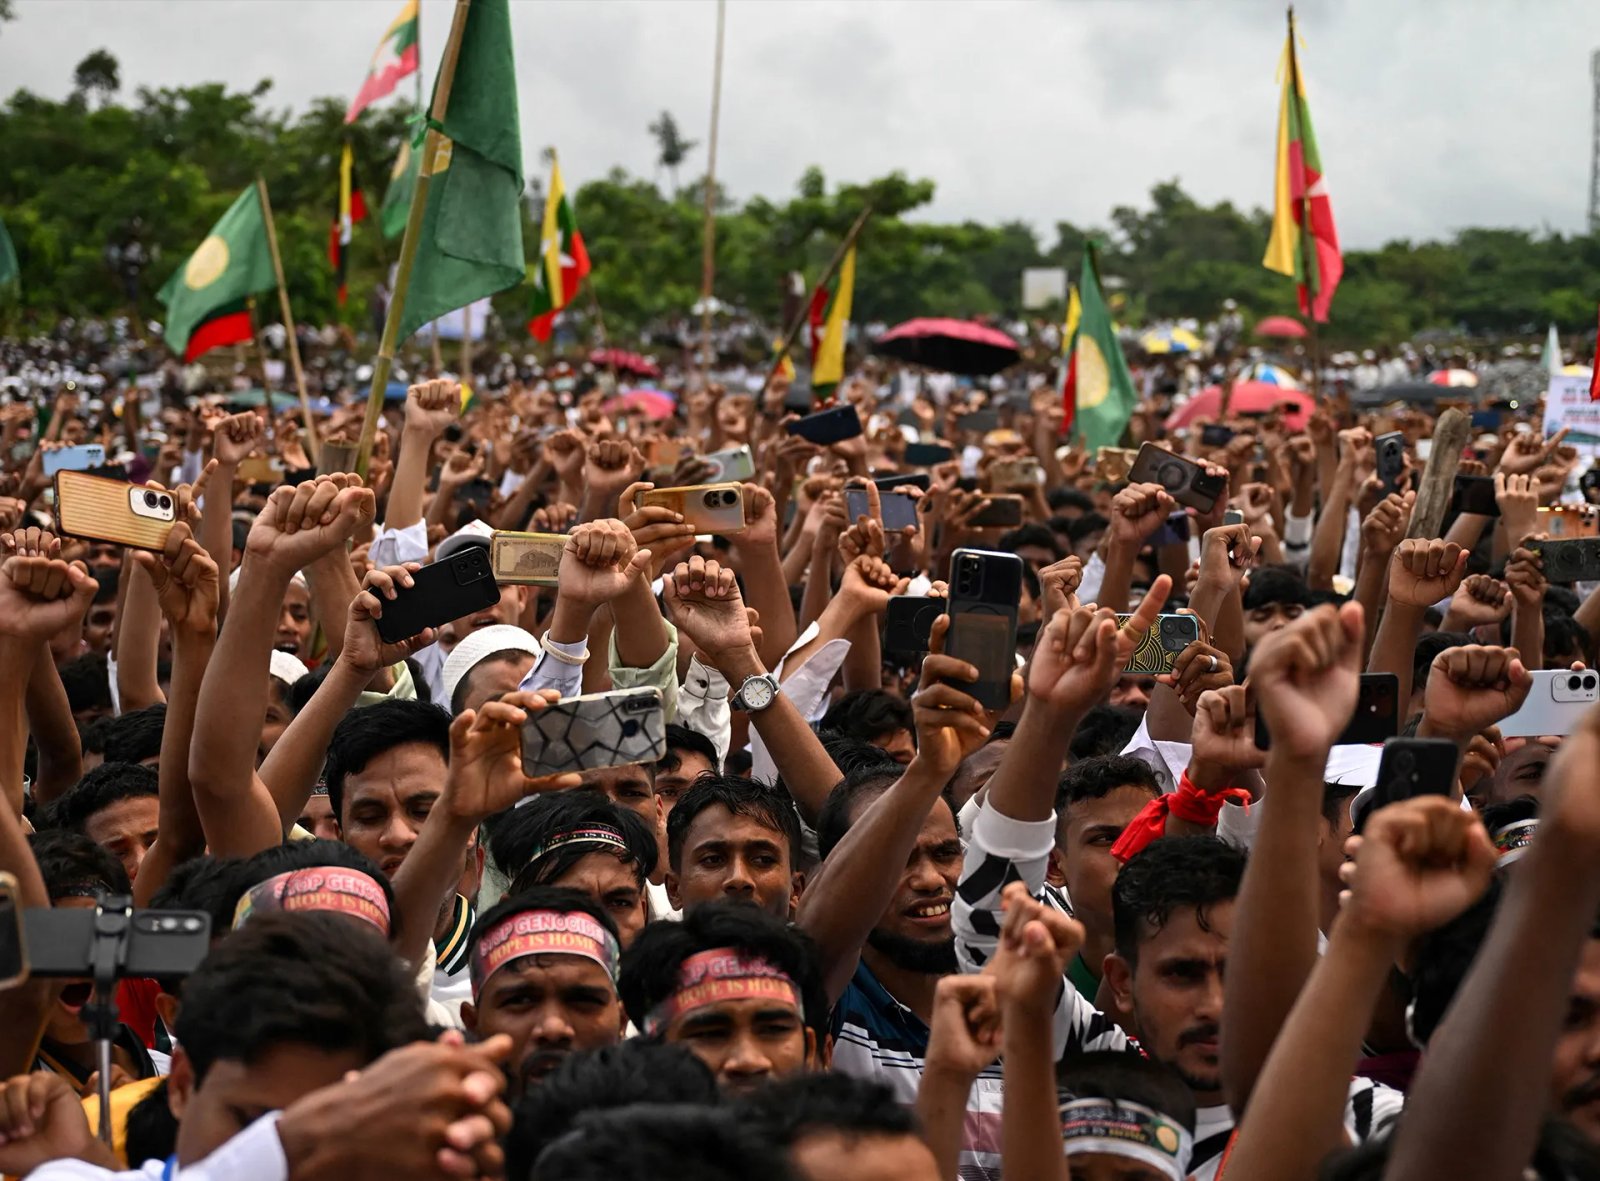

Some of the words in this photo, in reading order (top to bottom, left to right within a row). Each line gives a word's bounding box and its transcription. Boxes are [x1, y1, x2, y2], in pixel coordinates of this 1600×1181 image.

[288, 891, 336, 910] HOPE
[341, 893, 357, 909] IS
[513, 912, 605, 945] GENOCIDE
[488, 937, 526, 966] HOPE
[528, 933, 545, 947] IS
[551, 932, 598, 952] HOME
[677, 980, 722, 1008] HOPE
[726, 979, 745, 994] IS
[748, 976, 793, 998] HOME
